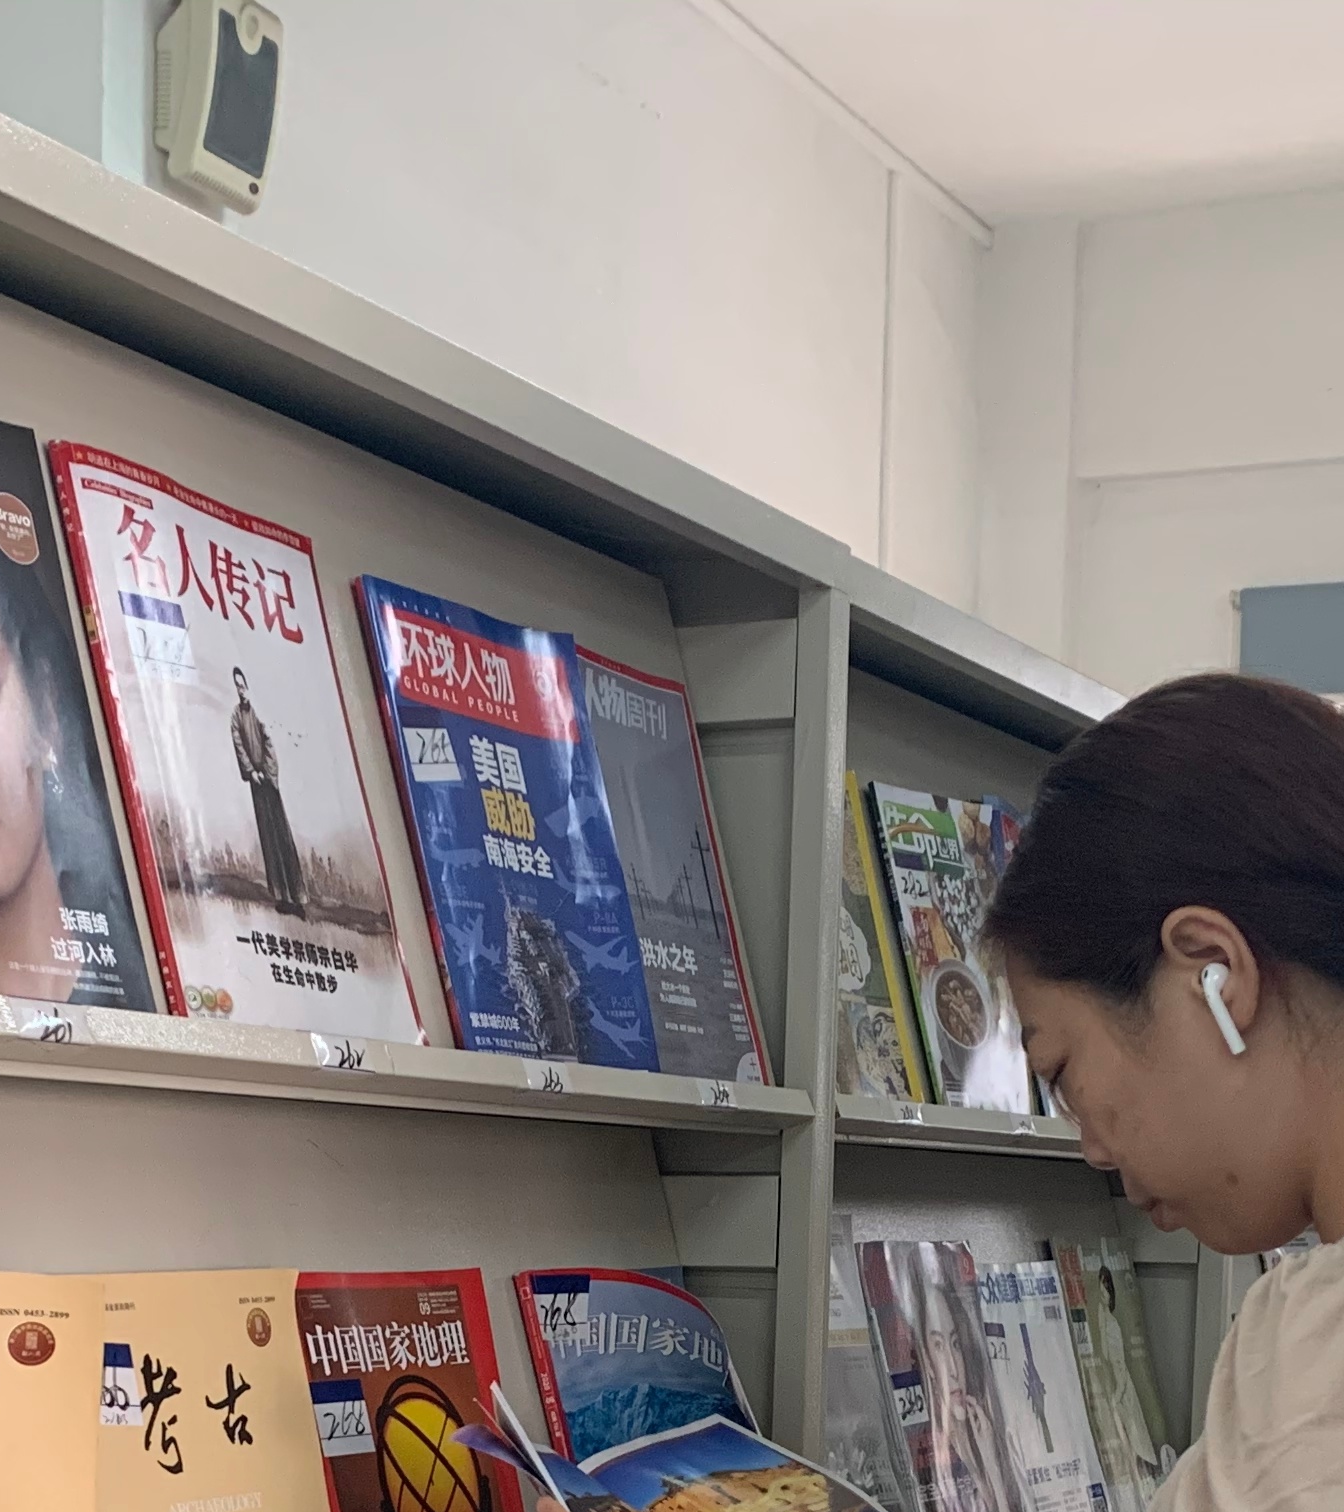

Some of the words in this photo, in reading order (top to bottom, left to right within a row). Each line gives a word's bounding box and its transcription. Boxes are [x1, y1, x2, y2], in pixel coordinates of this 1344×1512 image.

[117, 503, 304, 645] 名人传记
[395, 618, 516, 706] 环球人物
[403, 675, 458, 706] GLOBAL
[468, 696, 520, 723] PEOPLE
[585, 668, 669, 741] 人物周刊
[468, 734, 527, 795] 美国
[481, 787, 536, 842] 威胁
[482, 834, 554, 879] 南海安全
[60, 907, 111, 938] 张雨绮
[51, 935, 117, 968] 过河入林
[236, 931, 359, 974] 一代美学宗师宗白华
[639, 937, 698, 976] 洪水之年
[270, 962, 339, 994] 在生命中散步
[0, 1308, 21, 1317] ISSN
[419, 1302, 432, 1316] 09
[305, 1319, 471, 1377] 中国国家地理
[141, 1353, 254, 1475] 考古
